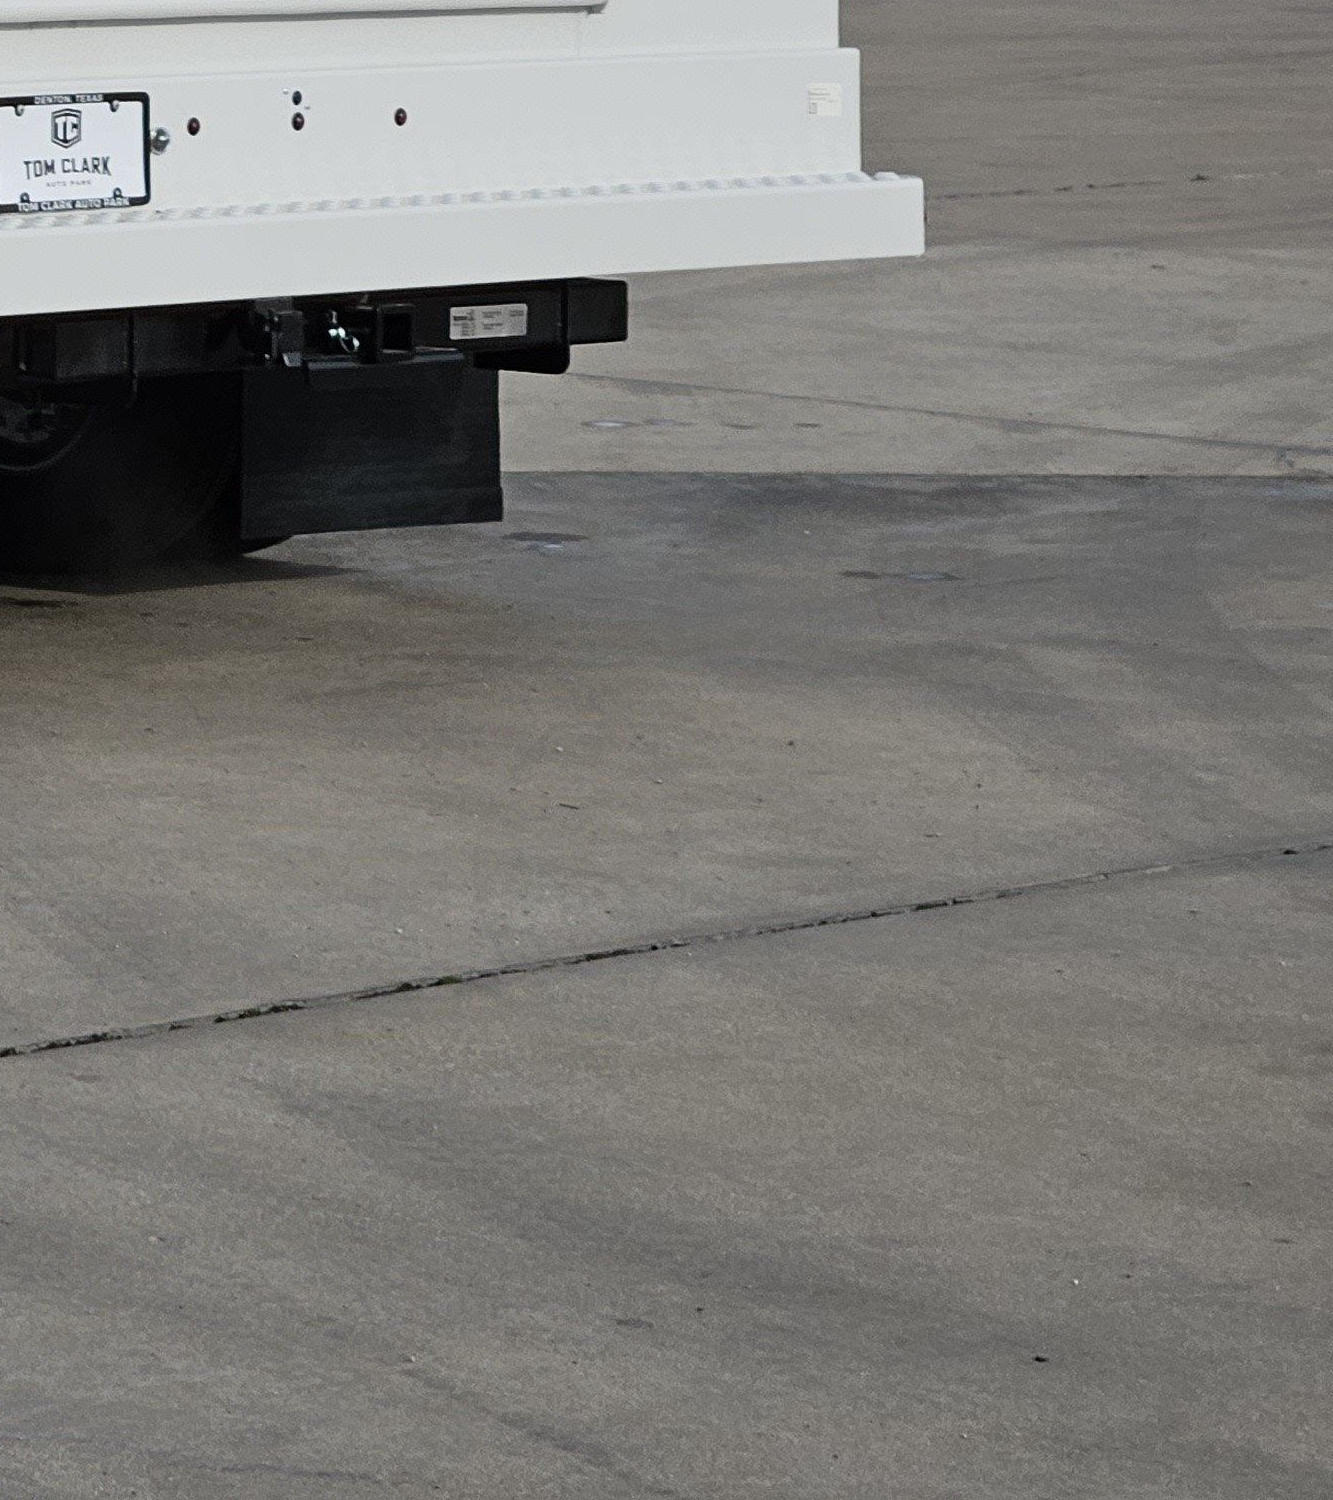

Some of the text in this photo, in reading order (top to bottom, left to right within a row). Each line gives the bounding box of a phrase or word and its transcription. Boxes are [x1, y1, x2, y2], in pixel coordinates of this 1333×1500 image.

[23, 155, 112, 180] TOM CLARK
[18, 197, 130, 212] TOM CLARK AUTO PARK
